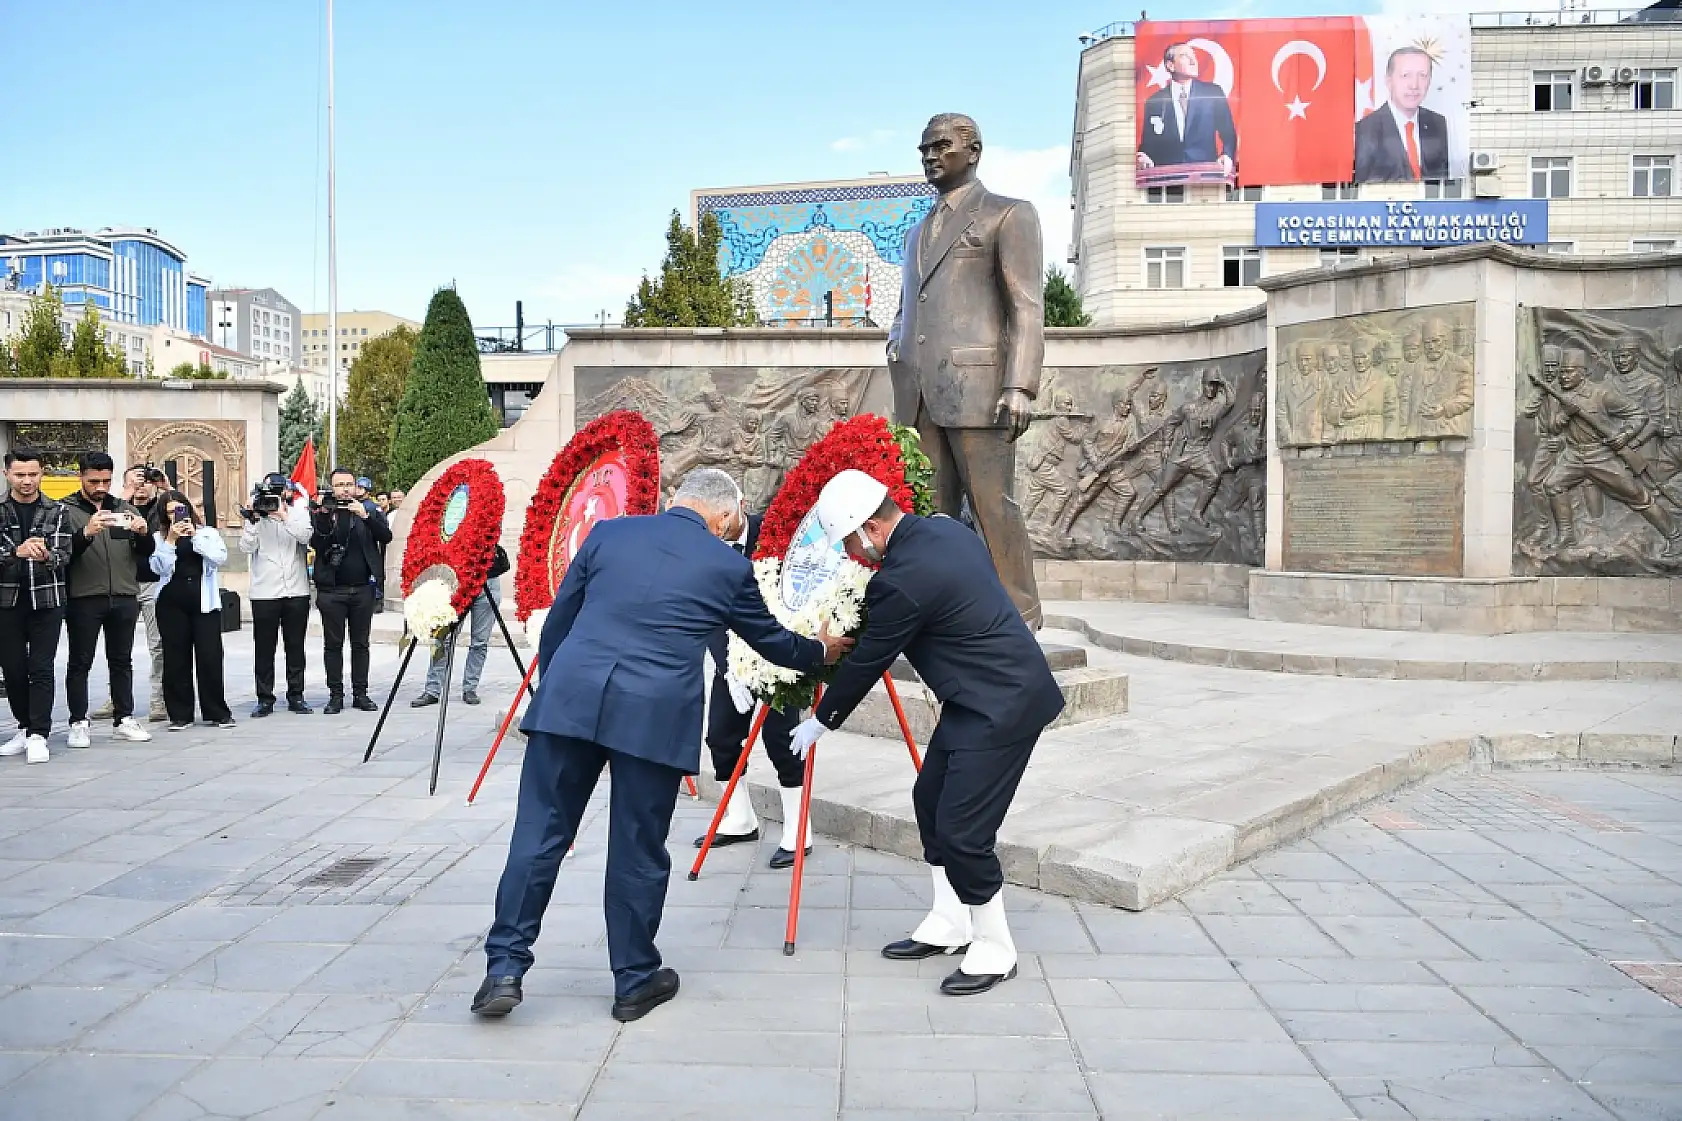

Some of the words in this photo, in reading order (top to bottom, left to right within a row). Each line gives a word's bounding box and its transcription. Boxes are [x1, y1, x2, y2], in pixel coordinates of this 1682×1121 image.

[1386, 202, 1418, 214] T.C.
[1277, 213, 1381, 229] KOCASİNAN
[1388, 211, 1527, 228] KAYMAKAMLIĞI
[1280, 228, 1322, 245] İLÇE
[1326, 227, 1407, 241] EMNİYET
[1410, 226, 1524, 241] MÜDÜRLÜĞÜ
